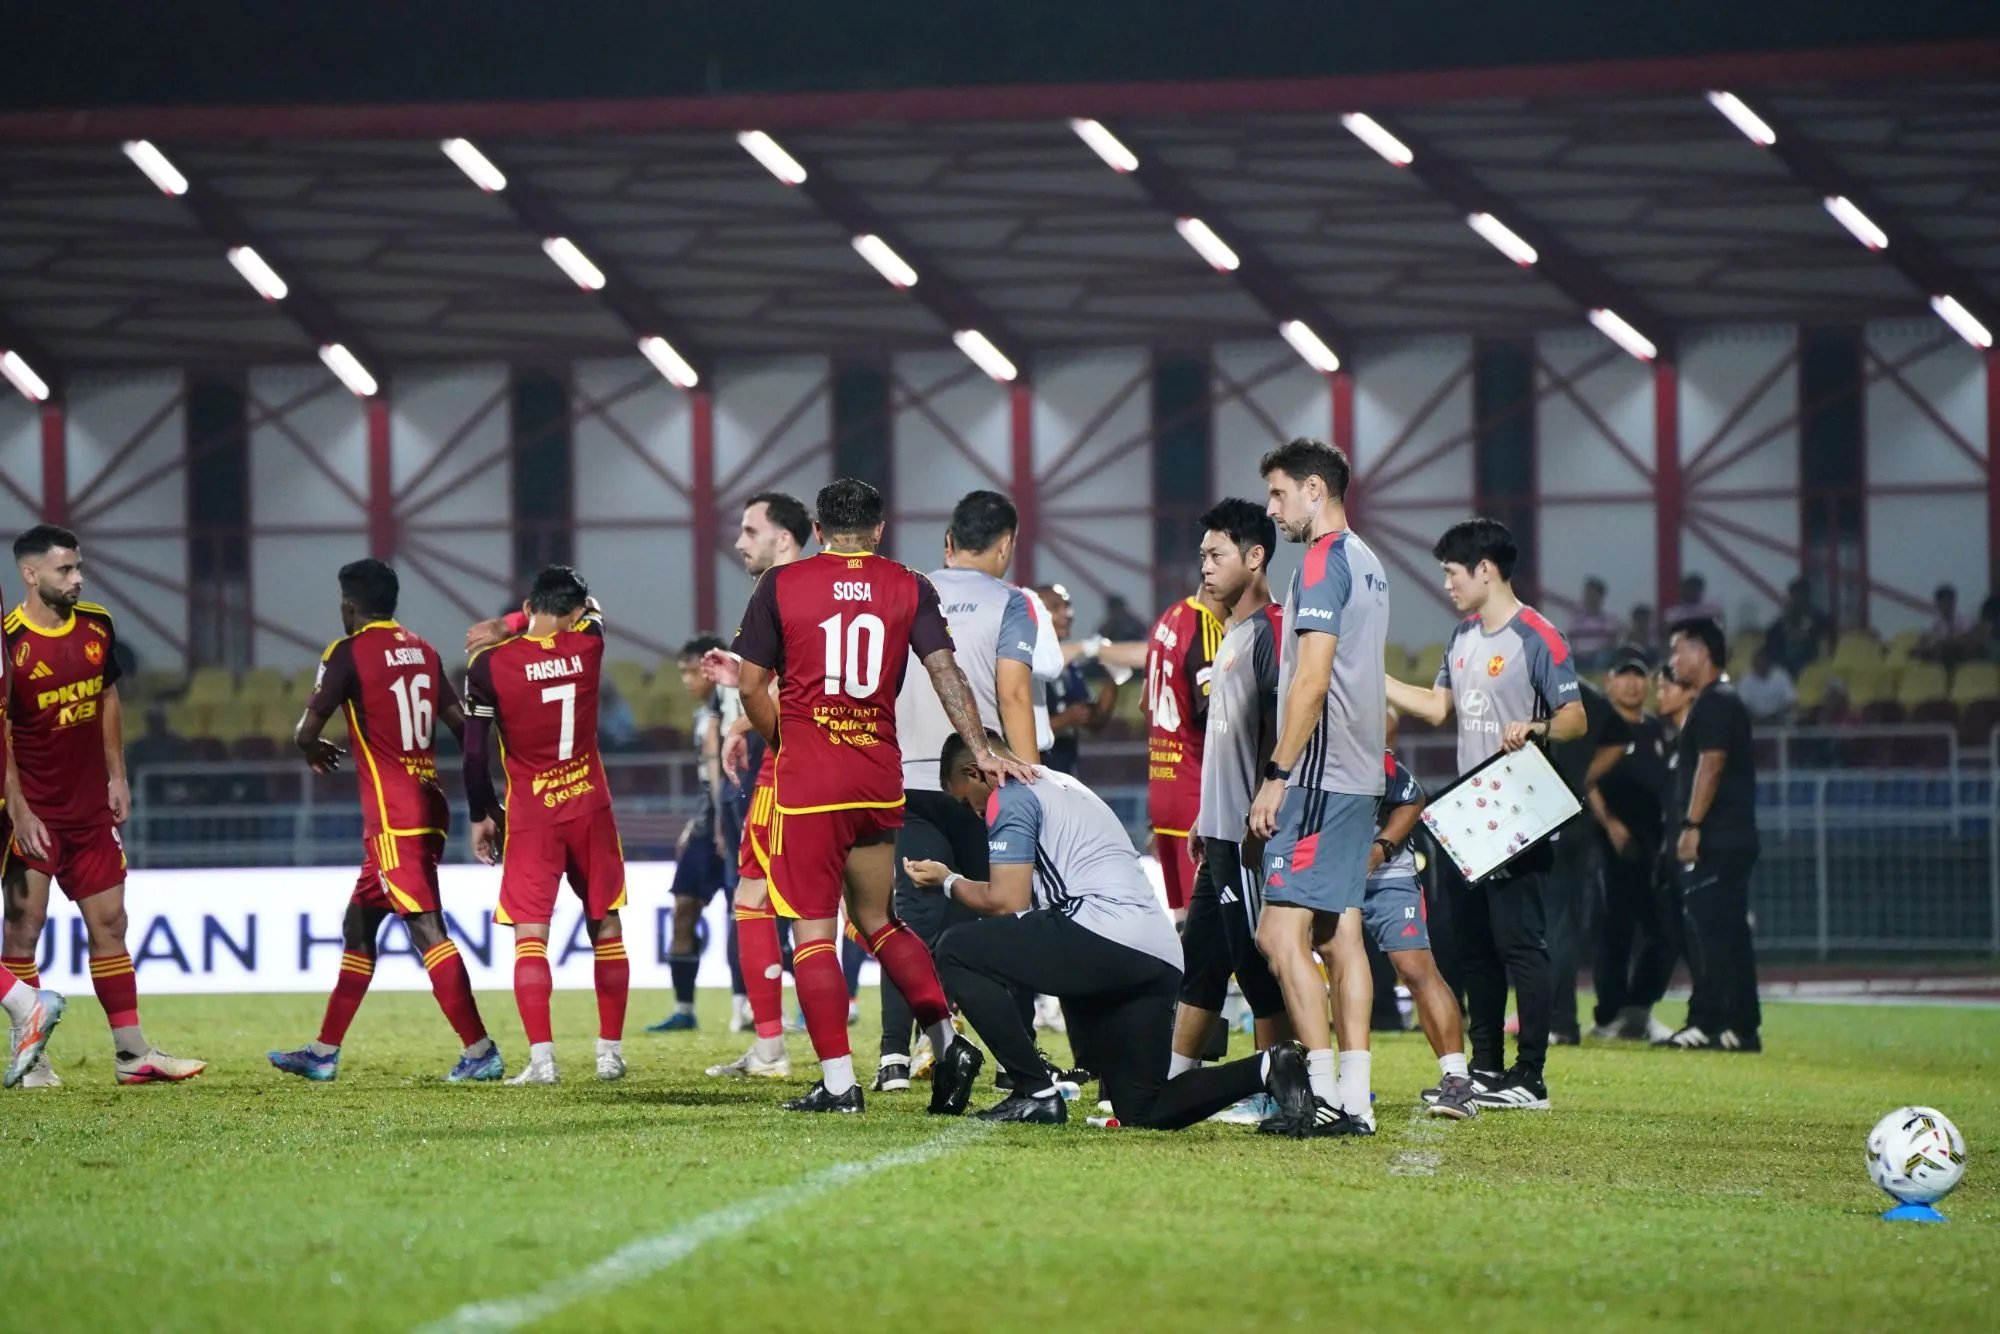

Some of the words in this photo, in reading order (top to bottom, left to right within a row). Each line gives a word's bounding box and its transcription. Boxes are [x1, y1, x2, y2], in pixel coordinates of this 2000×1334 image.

[833, 581, 873, 602] SOSA
[1297, 607, 1334, 620] SANI
[525, 655, 584, 682] FAISAL.H
[818, 611, 886, 699] 10
[37, 675, 104, 710] PKNS
[388, 673, 433, 752] 16
[541, 683, 576, 761] 7
[1272, 856, 1284, 869] JD
